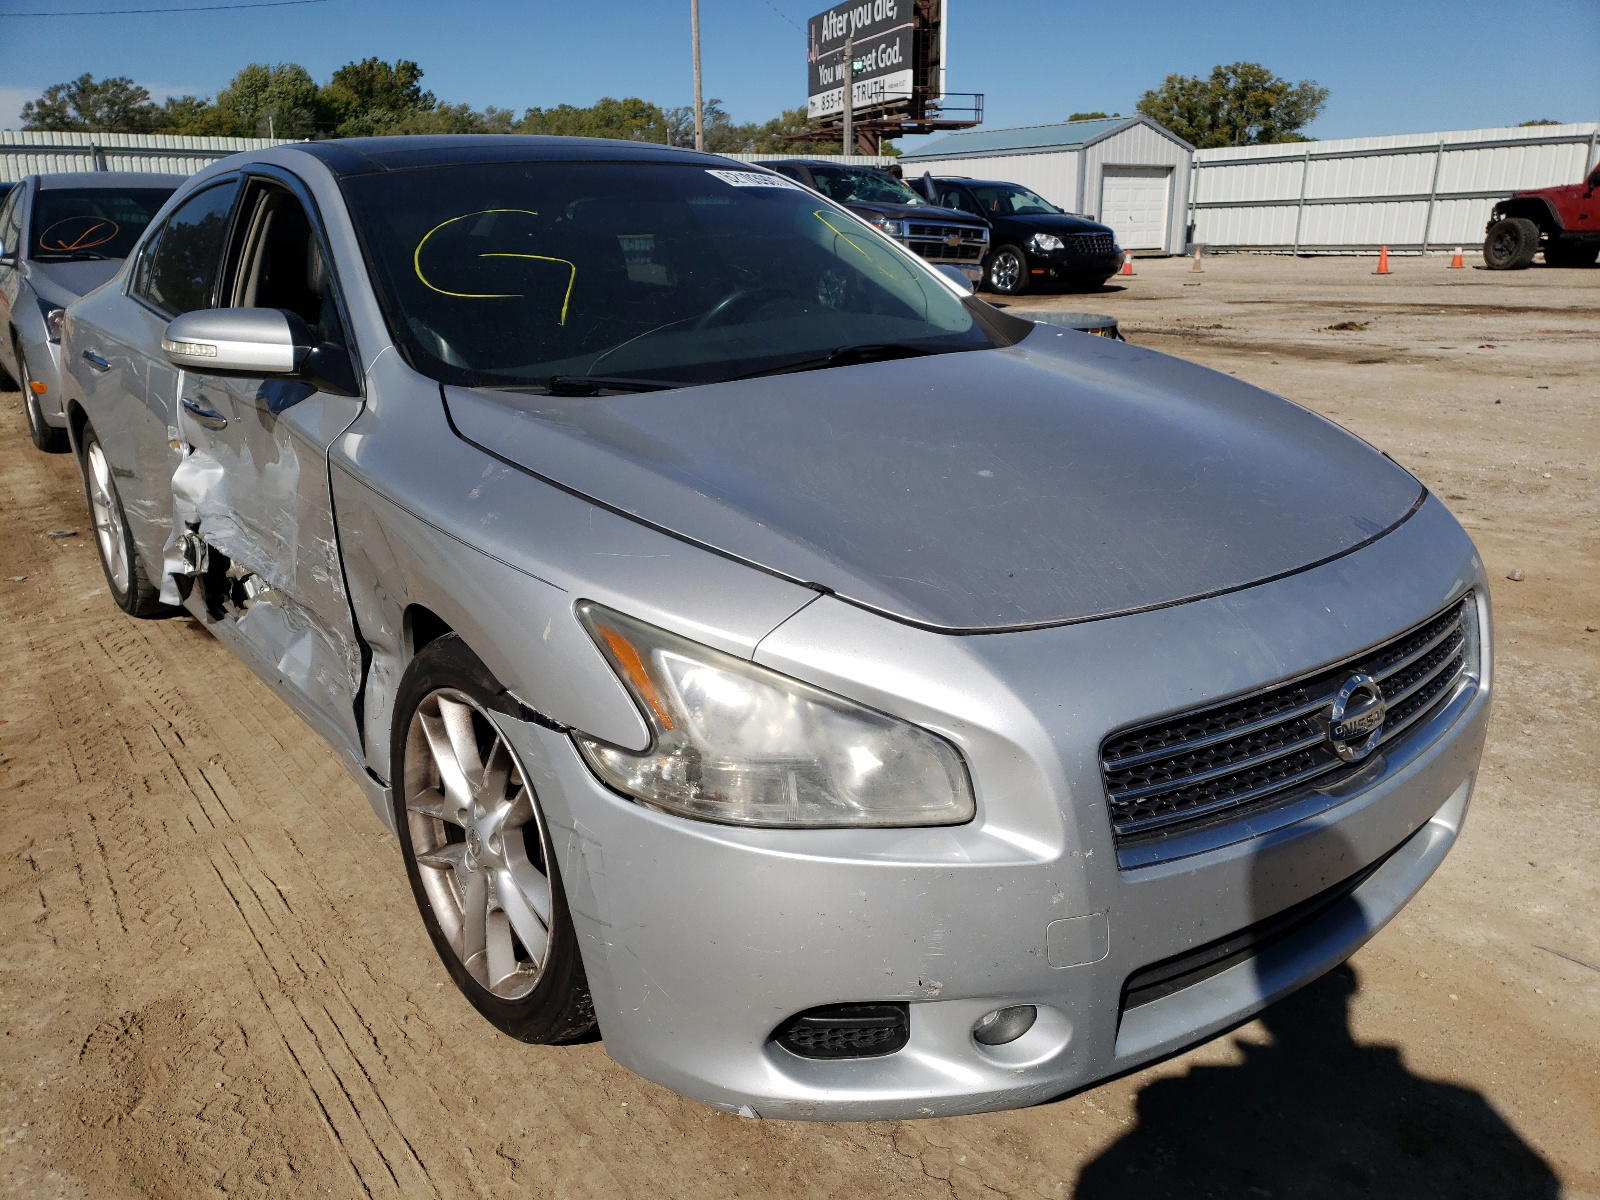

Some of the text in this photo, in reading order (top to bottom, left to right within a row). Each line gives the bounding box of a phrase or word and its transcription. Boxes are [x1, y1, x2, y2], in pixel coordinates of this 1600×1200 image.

[821, 10, 848, 43] After
[850, 2, 872, 38] you
[818, 64, 834, 86] You
[857, 49, 877, 74] eet
[878, 37, 903, 68] God.
[821, 79, 885, 111] 855-F-TRUTH
[1341, 705, 1385, 737] NISSAN
